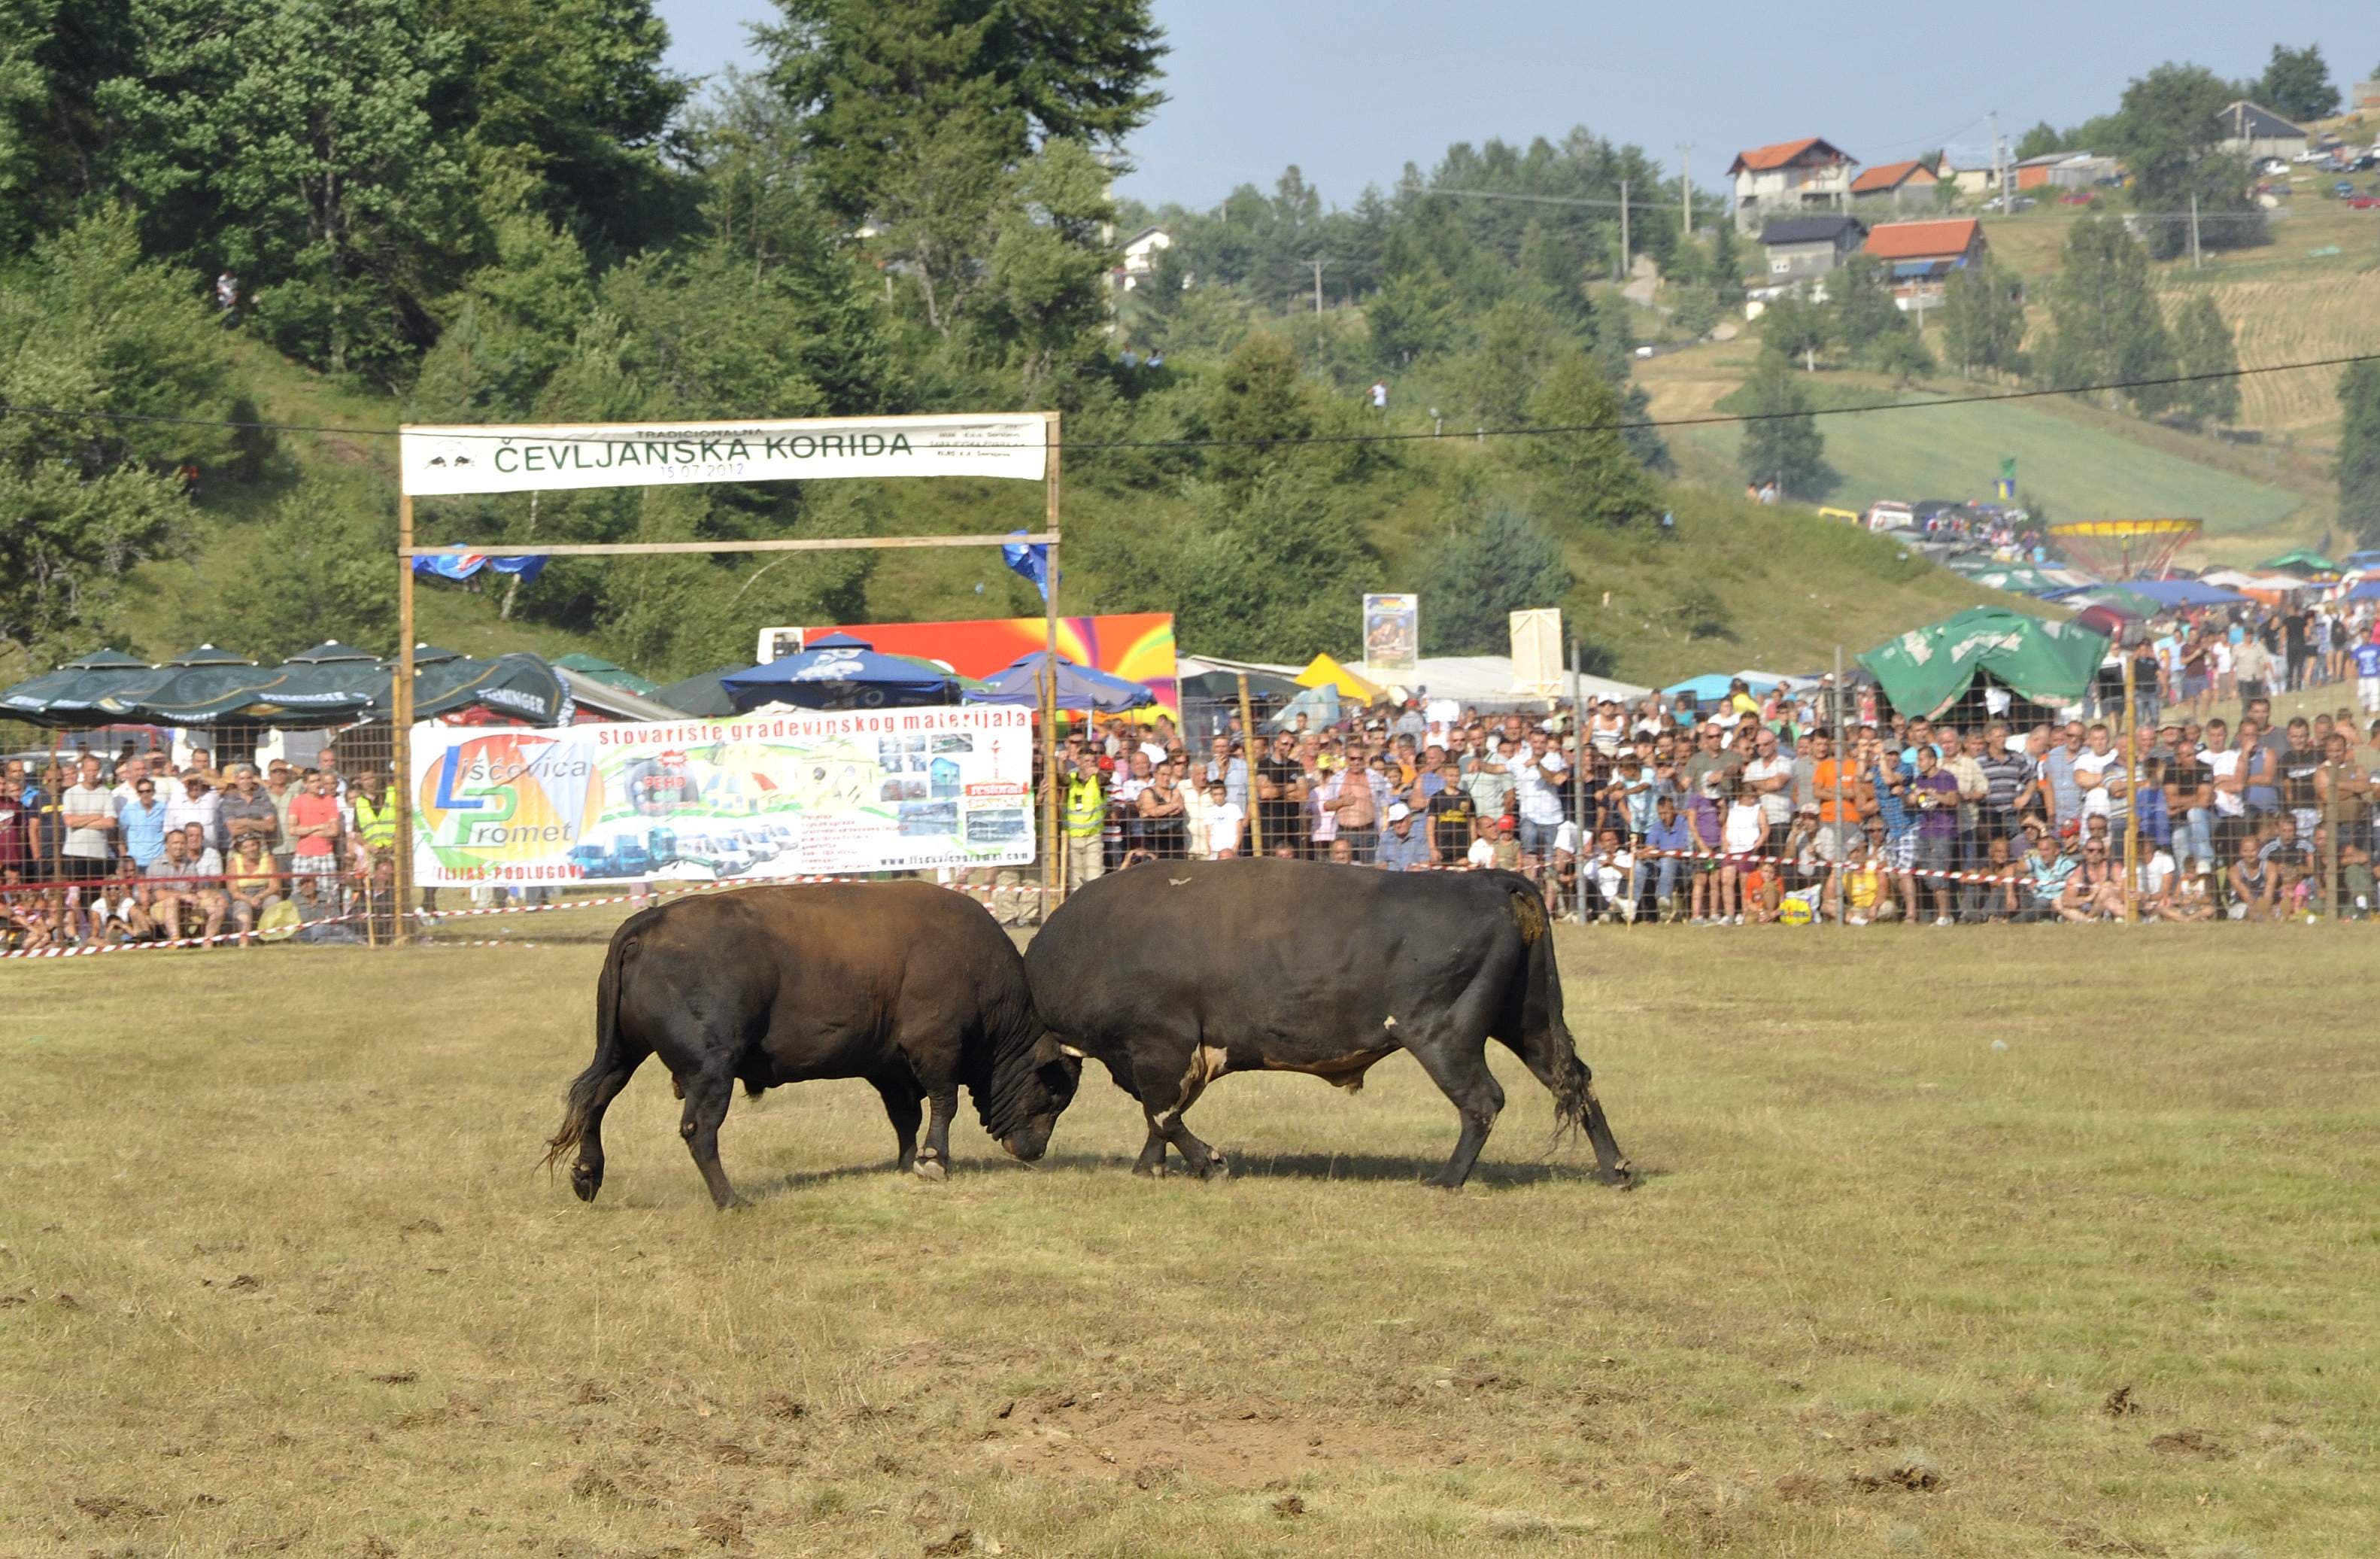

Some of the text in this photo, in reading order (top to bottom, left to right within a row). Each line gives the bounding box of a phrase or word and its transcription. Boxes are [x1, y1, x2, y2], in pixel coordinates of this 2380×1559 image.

[637, 430, 764, 439] TRADICIONALNA
[495, 433, 912, 473] ČEVLJANSKA KORIDA
[707, 463, 744, 476] 2012
[599, 724, 723, 745] stovarište
